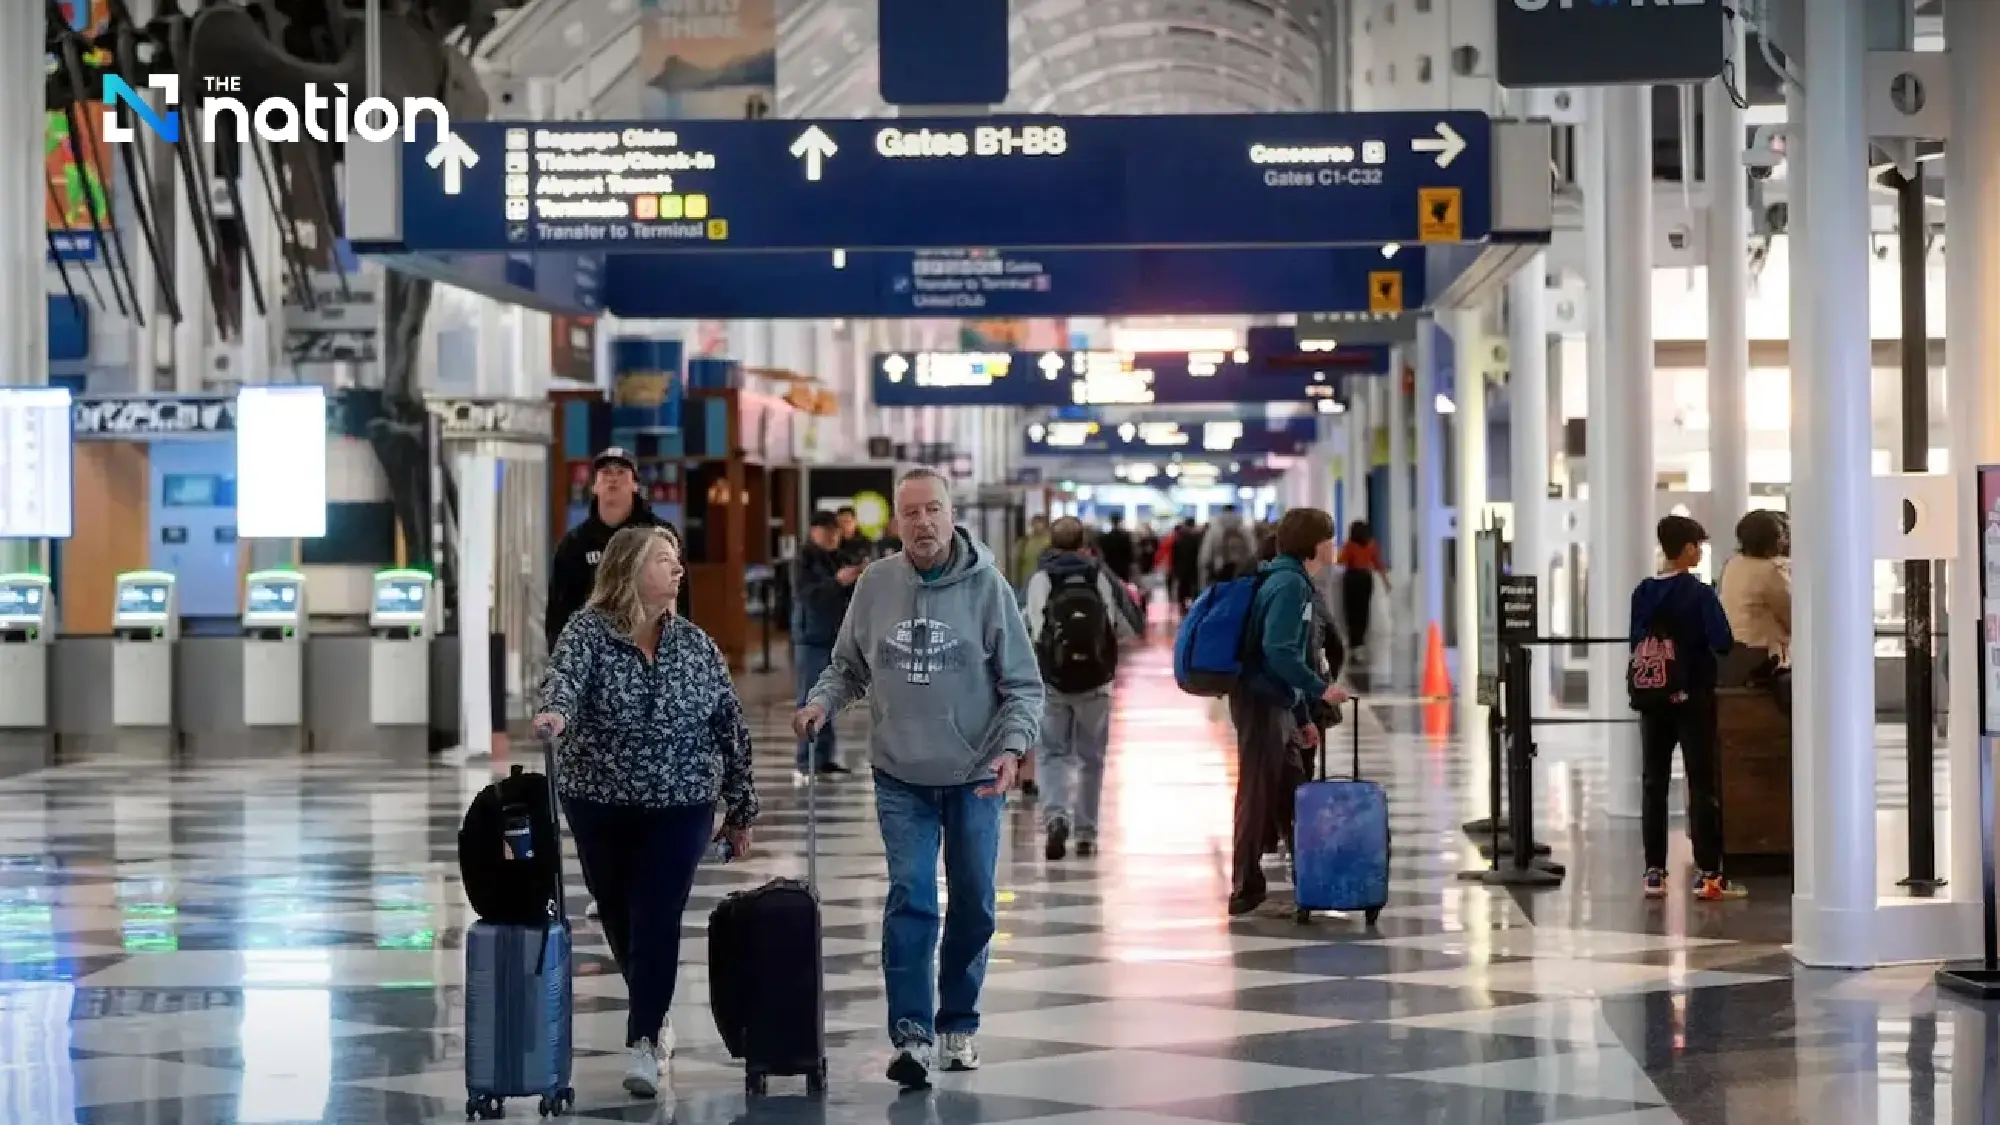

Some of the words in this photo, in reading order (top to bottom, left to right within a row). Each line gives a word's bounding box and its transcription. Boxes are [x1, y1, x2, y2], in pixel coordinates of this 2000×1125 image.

[876, 127, 968, 157] Gates
[975, 126, 1067, 155] B1-B8
[1265, 169, 1315, 186] Gates
[1317, 168, 1383, 185] C1-C32
[535, 222, 607, 240] Transfer
[609, 223, 628, 240] to
[632, 222, 704, 240] Terminal
[1501, 585, 1534, 596] Please
[1632, 659, 1667, 689] 23
